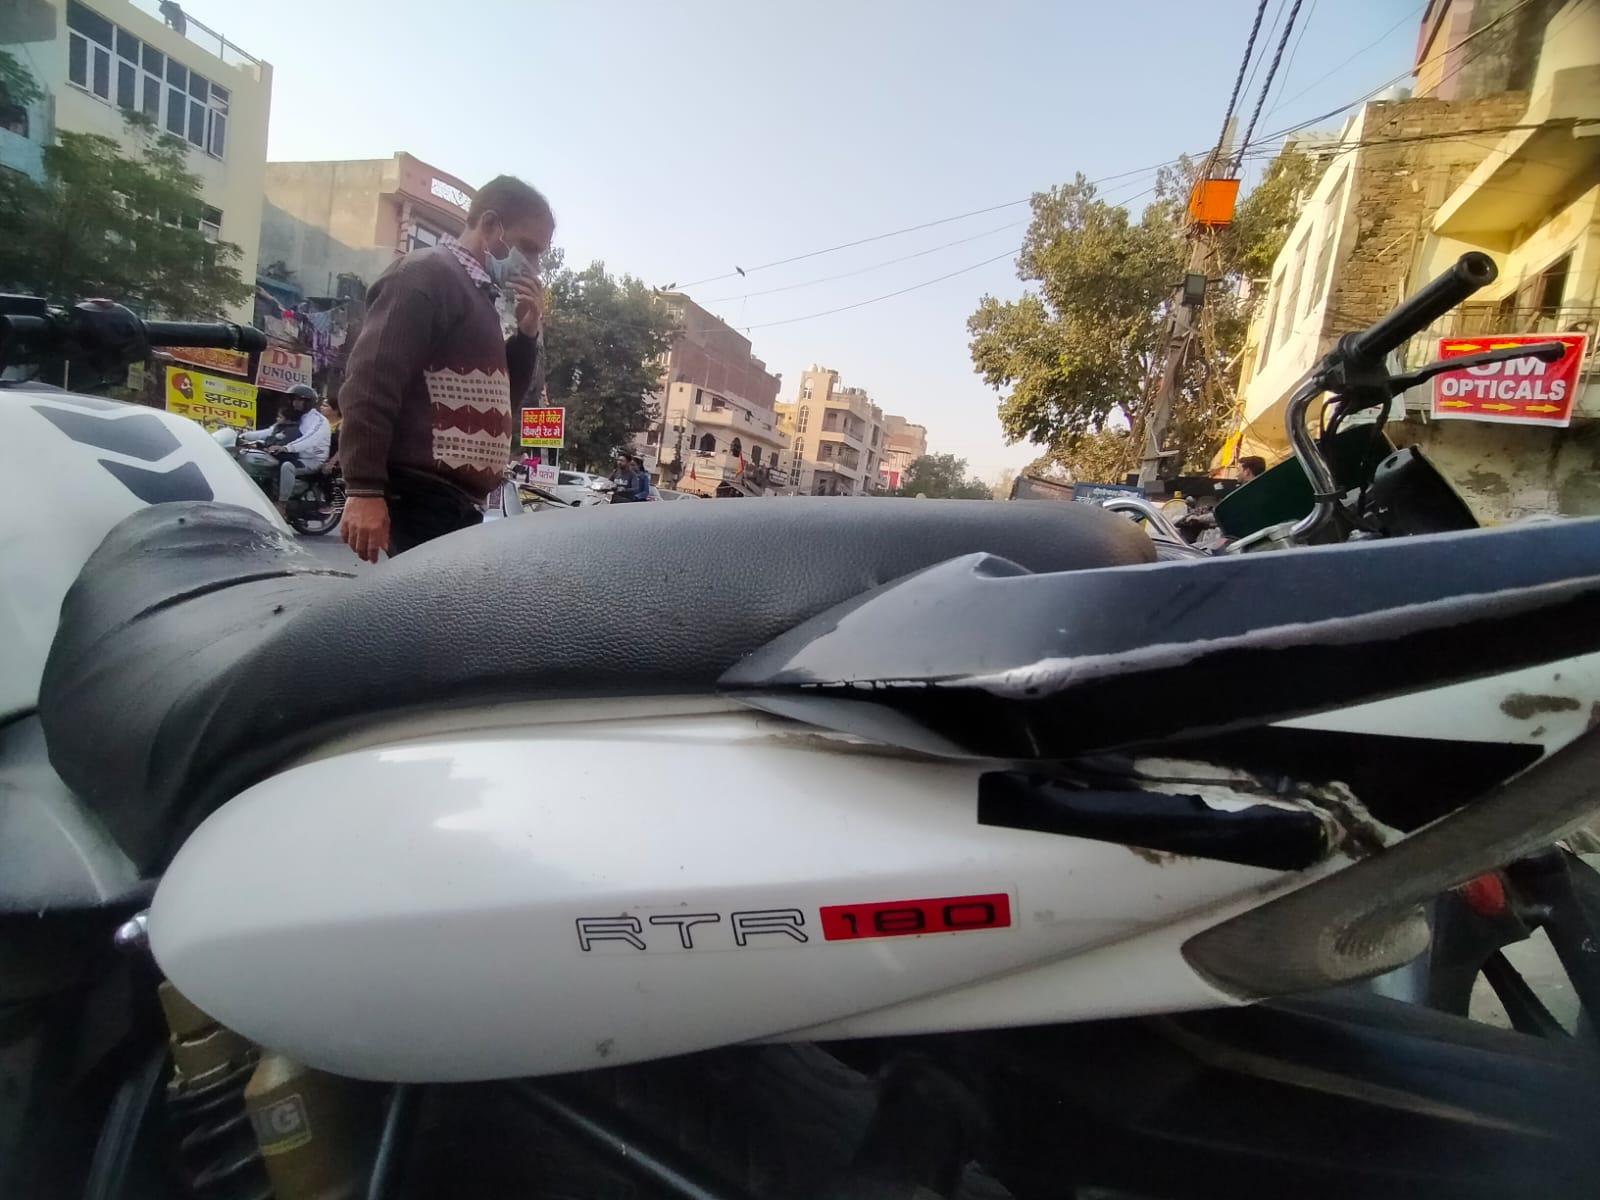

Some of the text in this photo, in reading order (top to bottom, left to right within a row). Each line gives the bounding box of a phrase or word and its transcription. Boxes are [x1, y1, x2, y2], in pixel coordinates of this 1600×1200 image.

[272, 349, 303, 369] DJ
[262, 365, 308, 384] UNIQUE
[1441, 378, 1566, 401] OPTICALS
[204, 391, 253, 411] झटका
[575, 902, 998, 952] RTR 180
